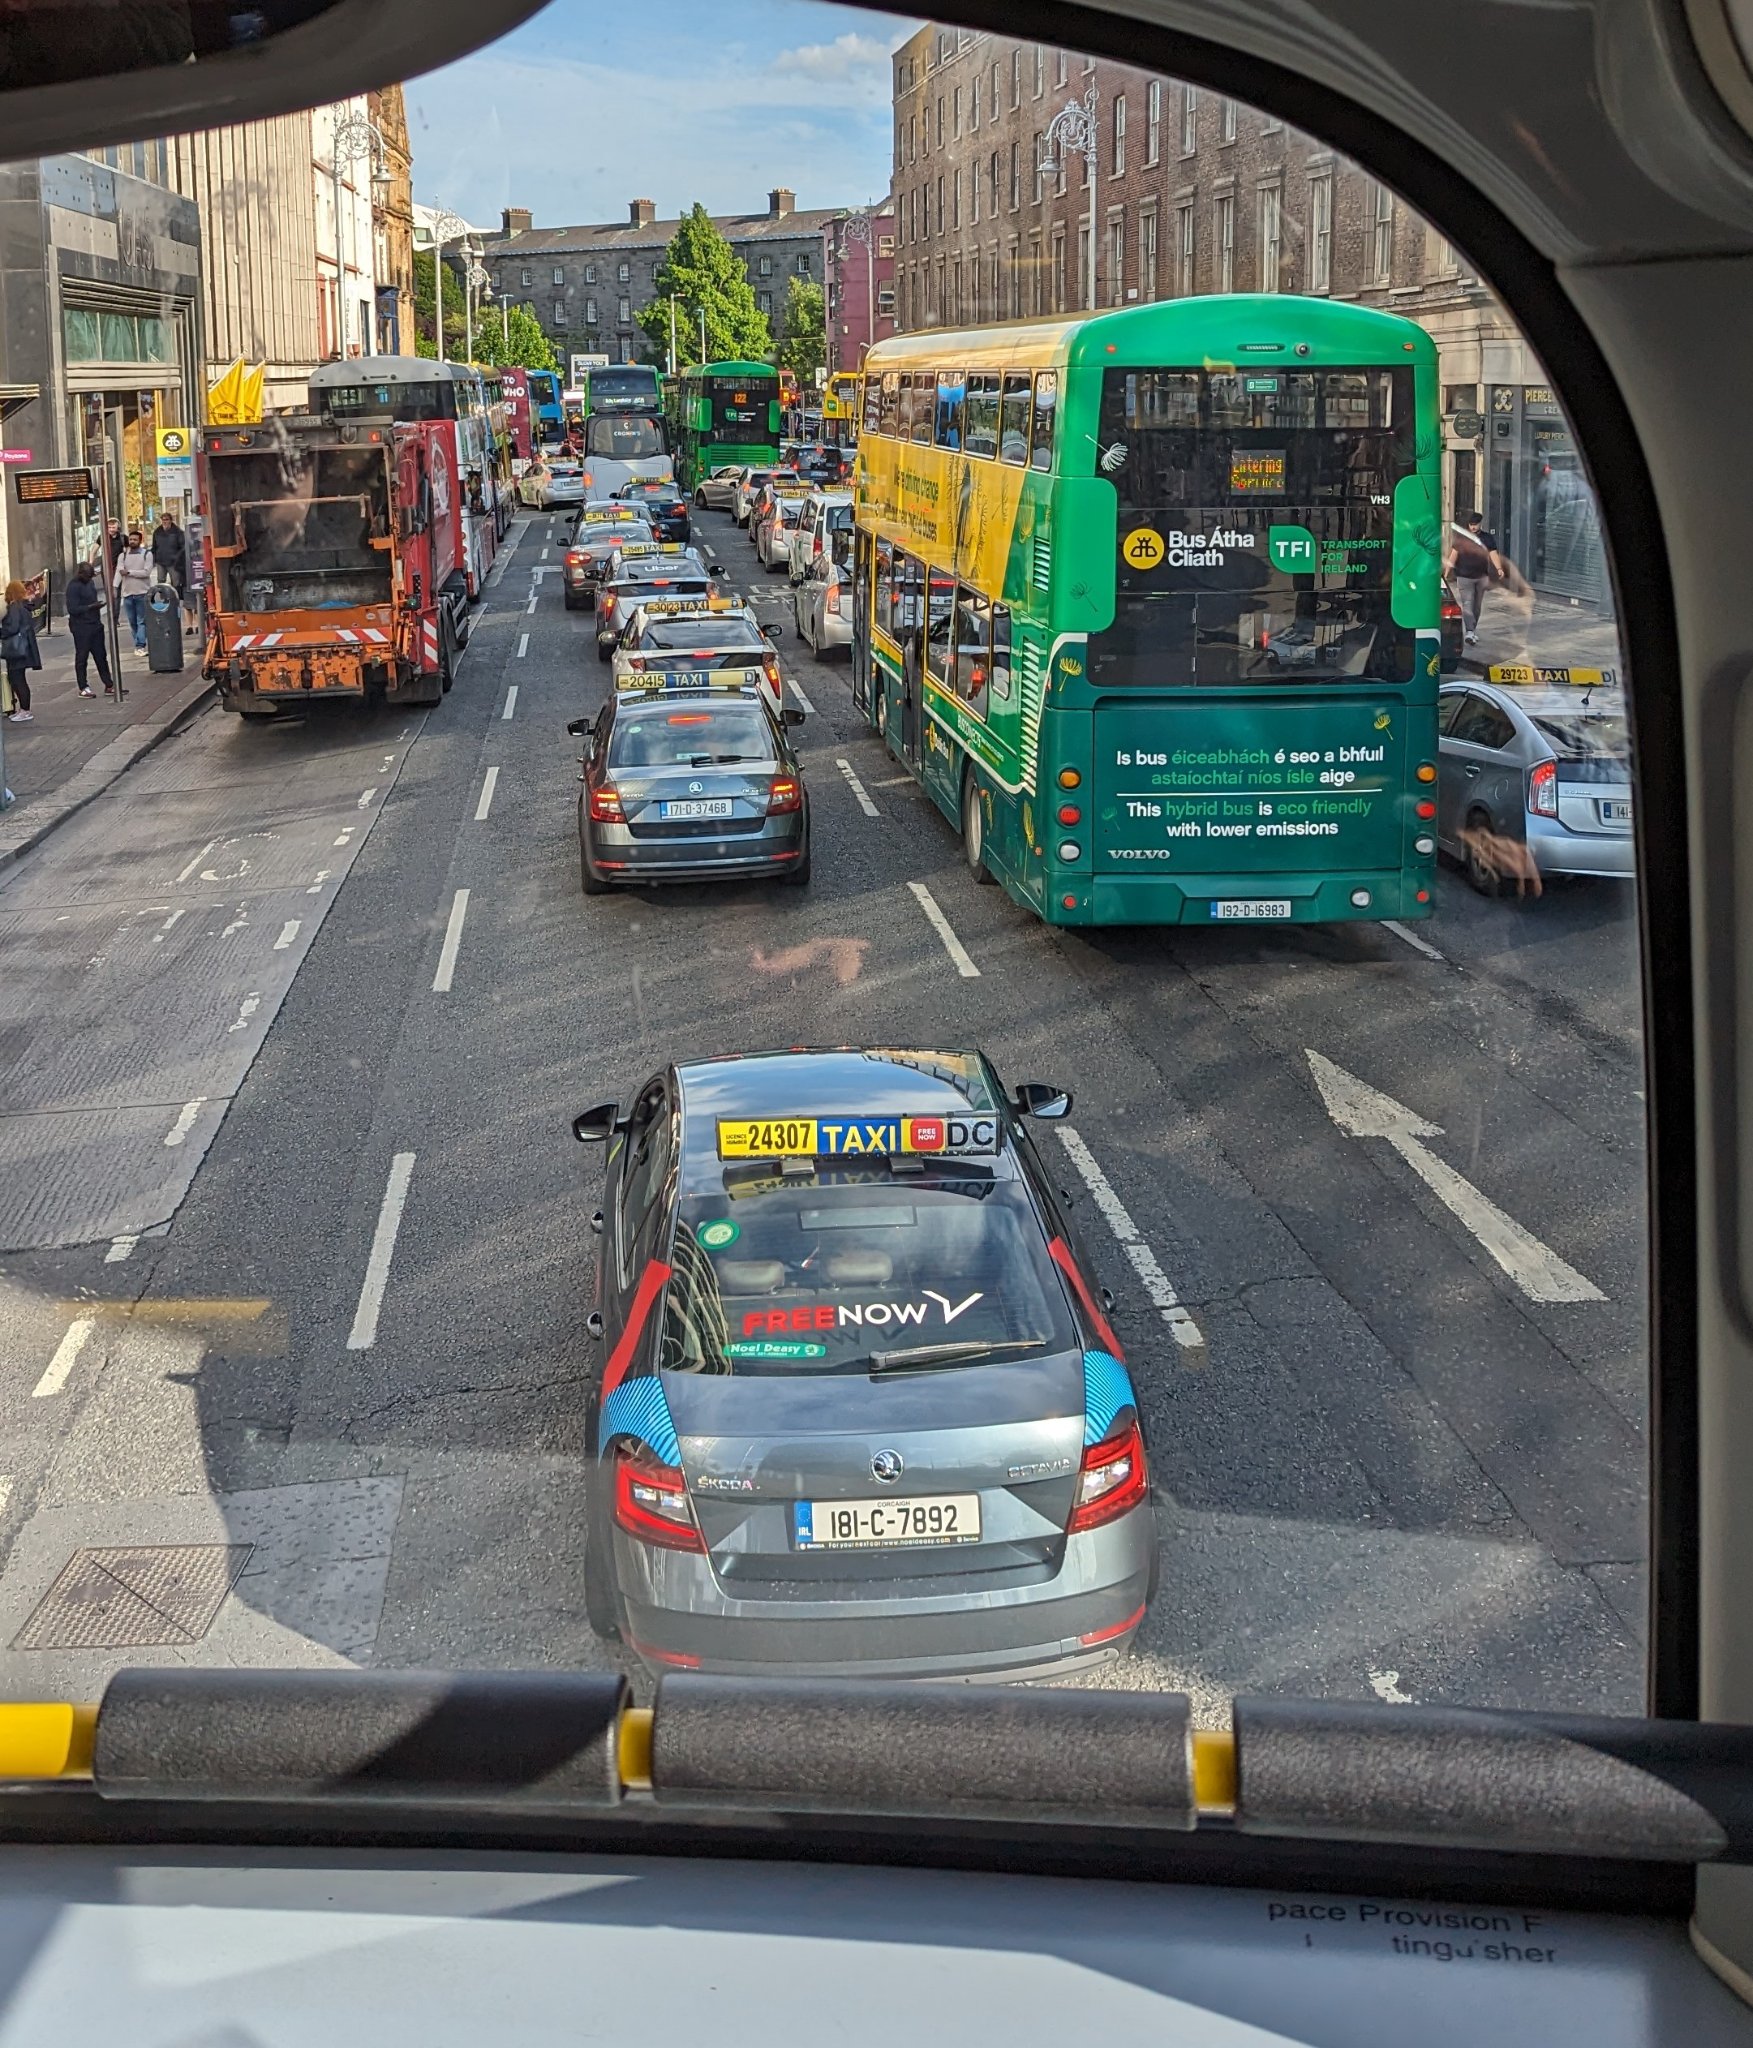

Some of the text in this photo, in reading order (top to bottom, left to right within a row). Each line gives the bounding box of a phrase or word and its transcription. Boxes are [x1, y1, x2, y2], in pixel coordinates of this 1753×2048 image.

[734, 393, 747, 404] 122
[1370, 495, 1391, 504] VH3
[1168, 526, 1254, 548] Bus Átha
[1321, 539, 1387, 550] TRANSPORT
[1275, 540, 1311, 558] TFI
[1321, 552, 1344, 562] FOR
[1167, 549, 1224, 567] Cliath
[1321, 564, 1368, 574] IRELAND
[682, 600, 708, 611] TAXI
[629, 672, 754, 688] 20415 TAXI D
[1500, 668, 1529, 681] 29723
[1535, 669, 1569, 682] TAXI
[1116, 750, 1132, 766] Is
[1135, 749, 1168, 766] bus
[1171, 748, 1269, 765] éiceabhách
[1274, 748, 1286, 764] é
[1289, 751, 1321, 764] seo
[1324, 751, 1335, 763] a
[1151, 768, 1355, 787] astaíochtaí níos ísle aige
[670, 803, 727, 816] 171-D-37468
[1126, 798, 1373, 820] This hybrid bus is eco friendly
[1166, 820, 1339, 837] with lower emissions
[1108, 849, 1171, 860] VOLVO
[1222, 904, 1285, 917] 192-D-16983
[748, 1123, 897, 1153] 24307 TAXI
[917, 1133, 936, 1141] NOW
[947, 1120, 994, 1147] DC
[730, 1343, 801, 1355] Noel Deasy
[1007, 1458, 1071, 1478] OCTAVIA
[697, 1475, 753, 1491] ŠKODA
[877, 1500, 911, 1508] CORCAIGH
[830, 1504, 959, 1539] 181-C-7892
[798, 1527, 811, 1536] IRL
[1358, 1903, 1512, 1932] Provision
[1392, 1934, 1558, 1963] tingusher
